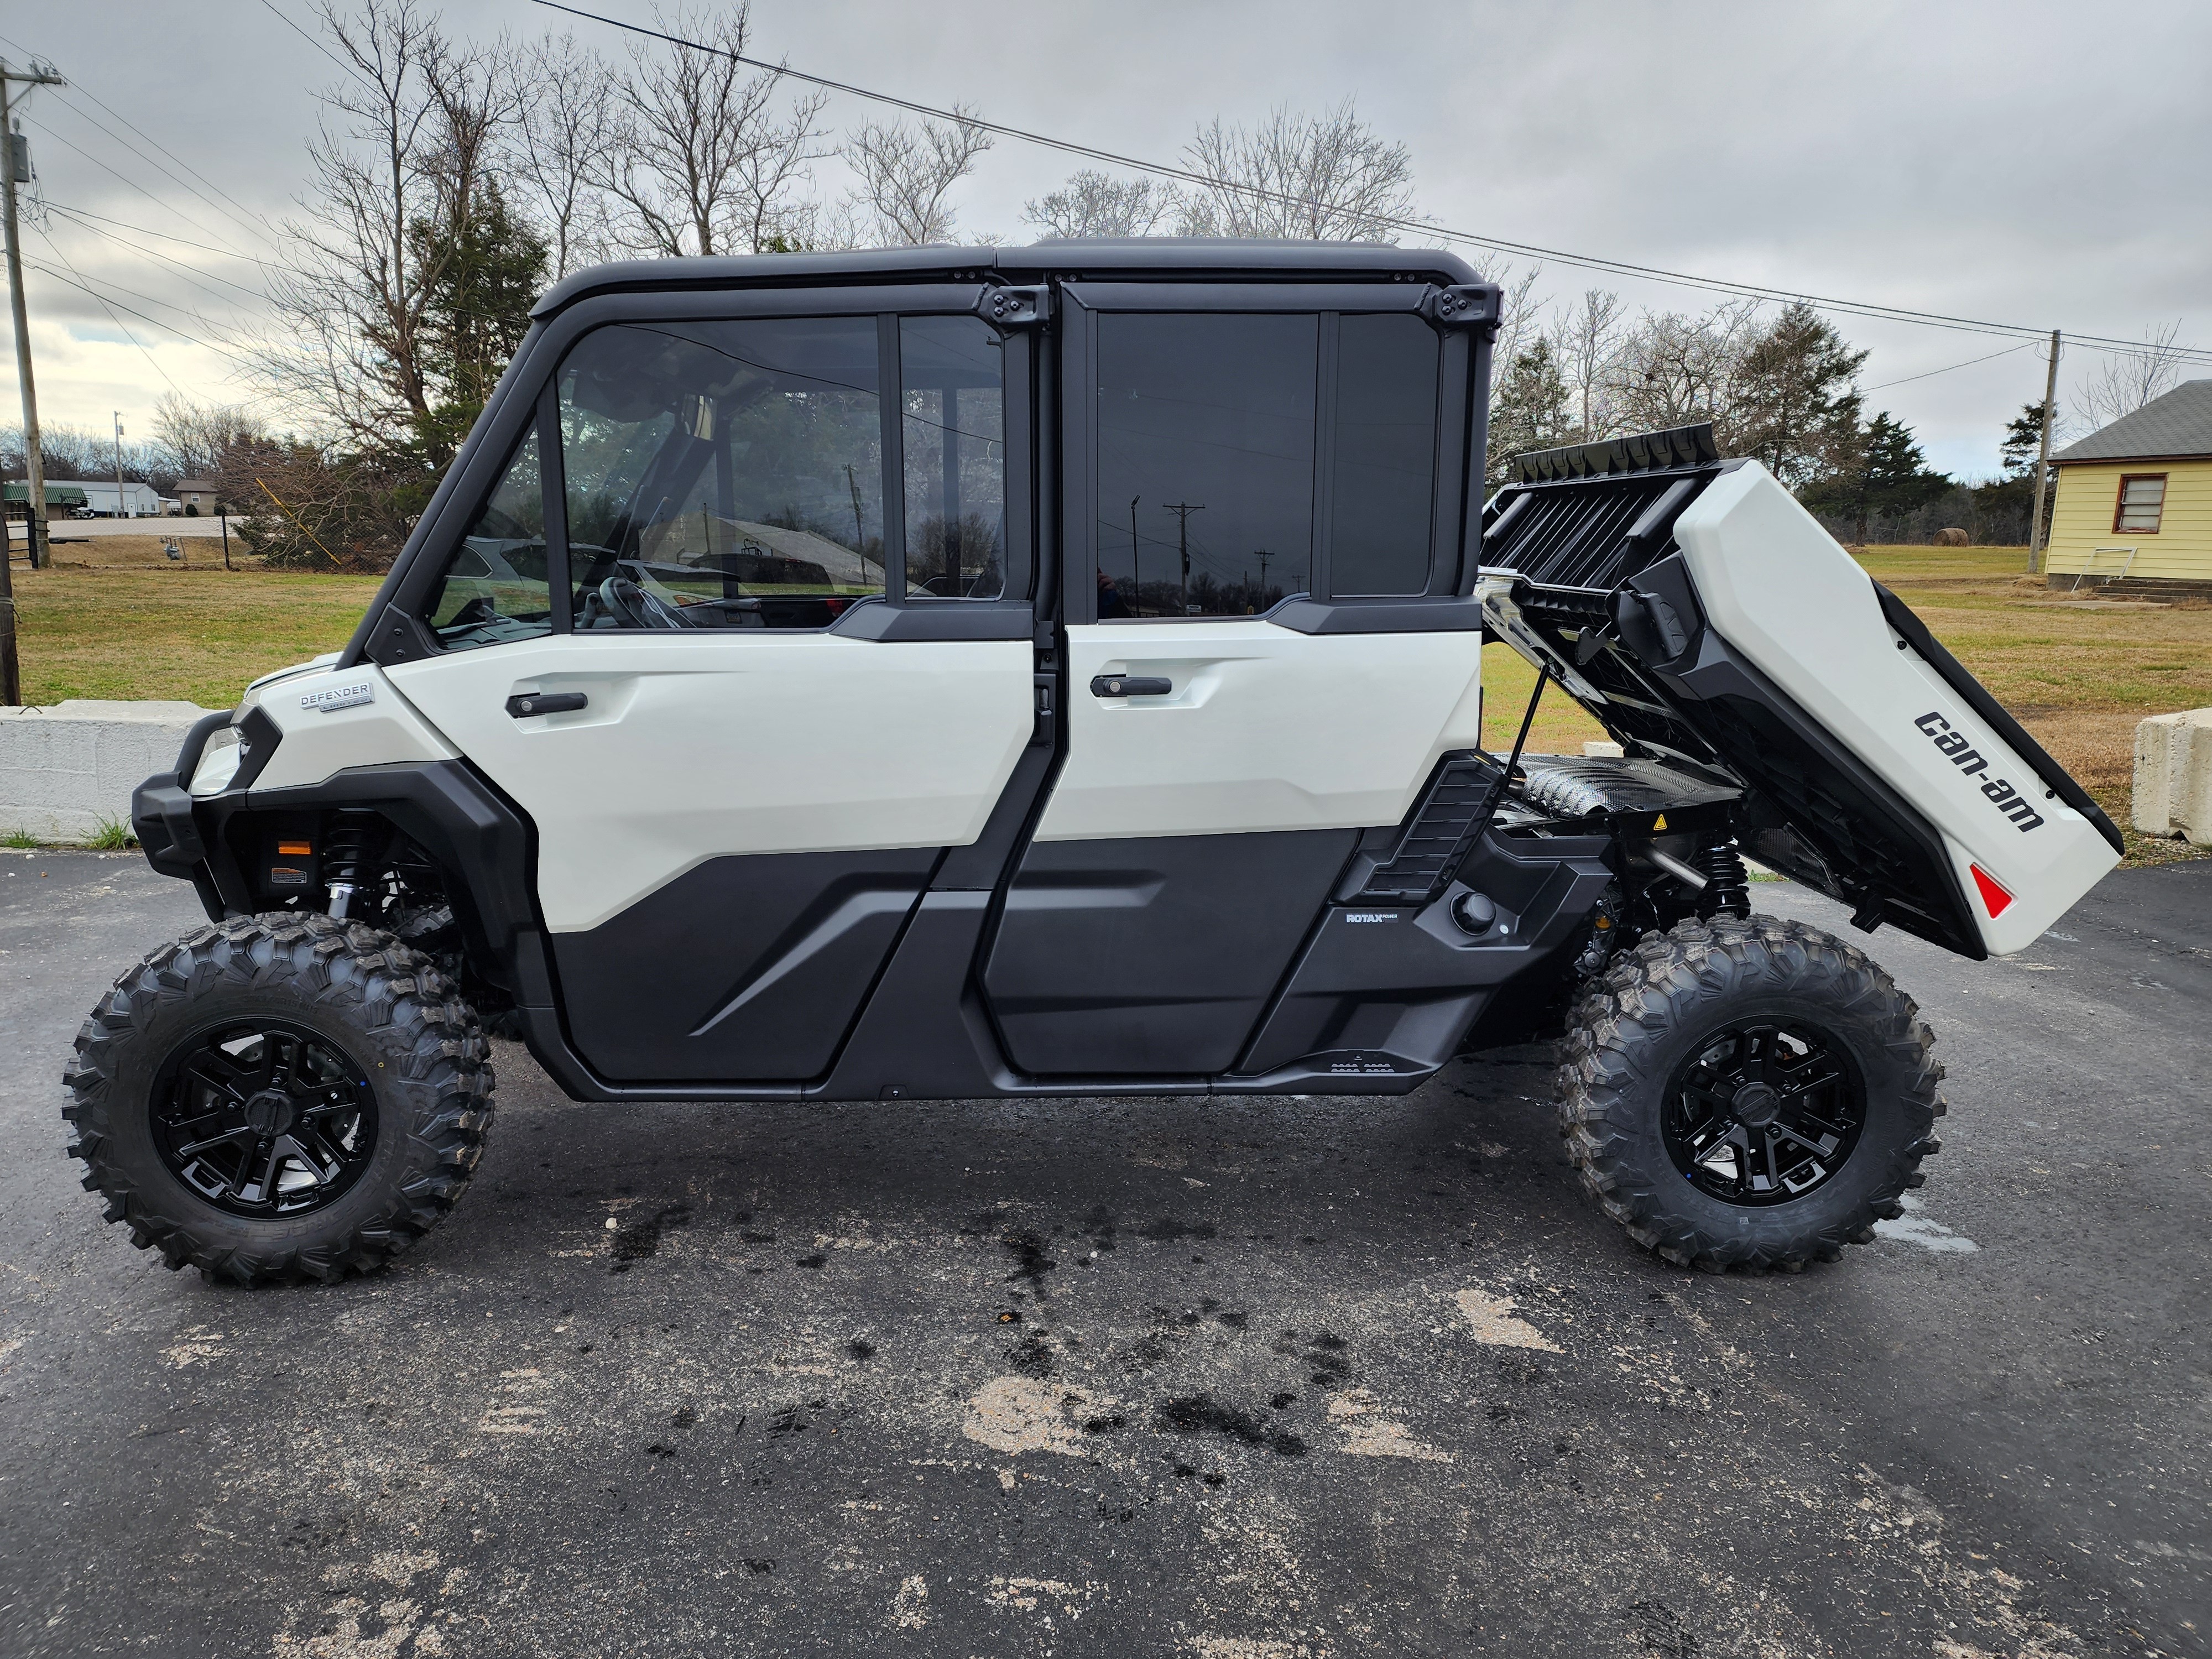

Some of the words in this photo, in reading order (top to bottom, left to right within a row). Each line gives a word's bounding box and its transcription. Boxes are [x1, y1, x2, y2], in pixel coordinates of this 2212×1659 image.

[301, 685, 368, 705] DEFENDER
[1914, 711, 2044, 833] can-am
[1346, 914, 1383, 923] ROTAX
